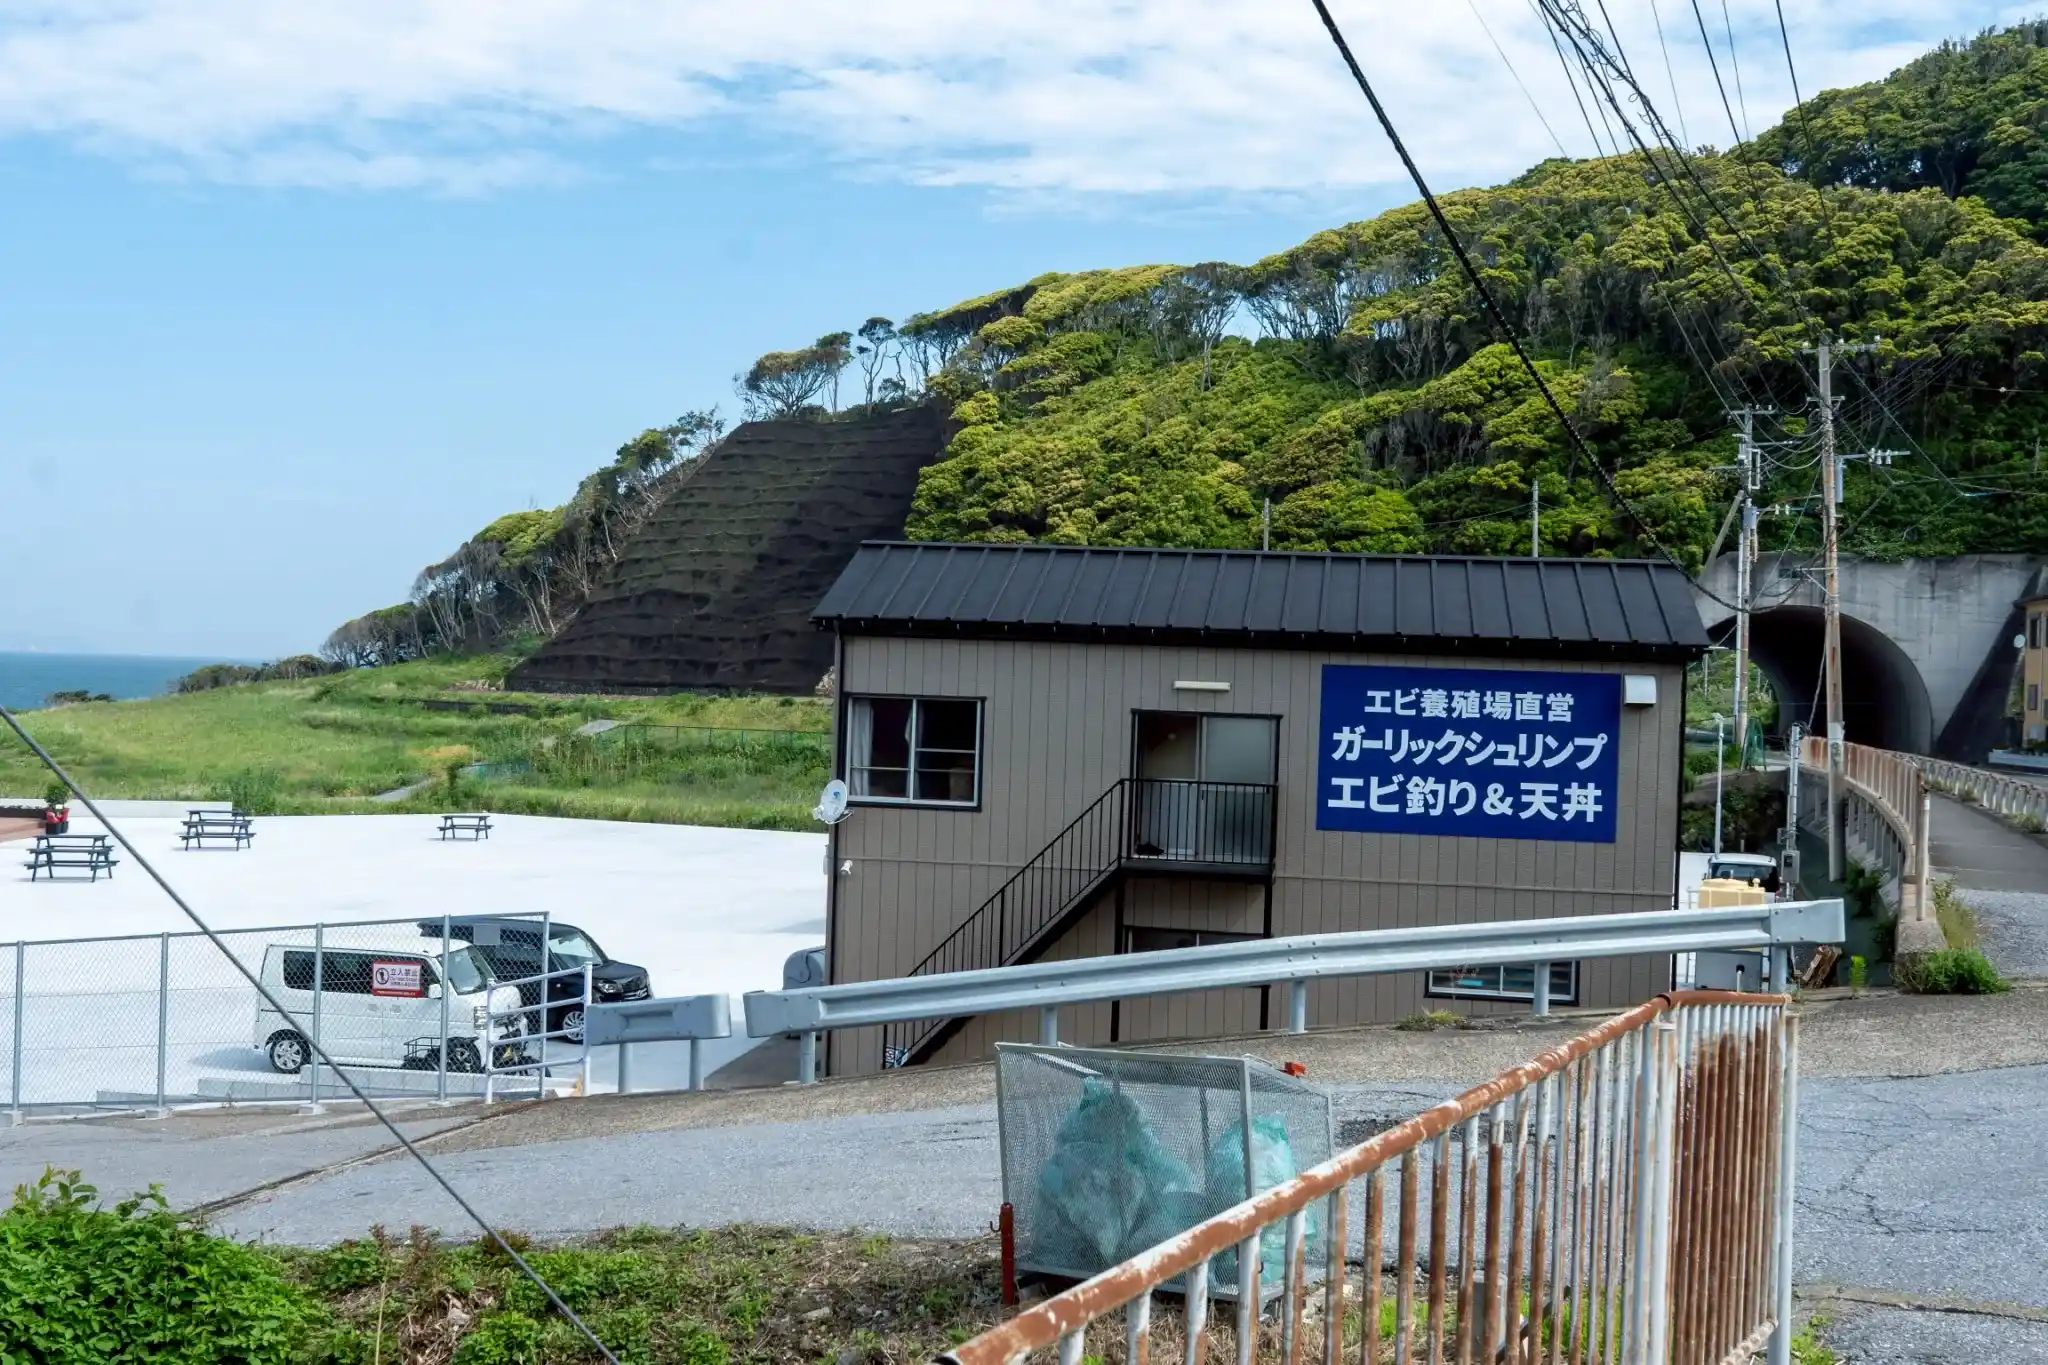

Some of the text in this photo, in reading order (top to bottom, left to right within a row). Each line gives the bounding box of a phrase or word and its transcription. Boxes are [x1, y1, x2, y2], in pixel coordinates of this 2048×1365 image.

[1364, 688, 1574, 722] エビ養殖場直営
[1332, 726, 1608, 770] ガーリックシュリンプ
